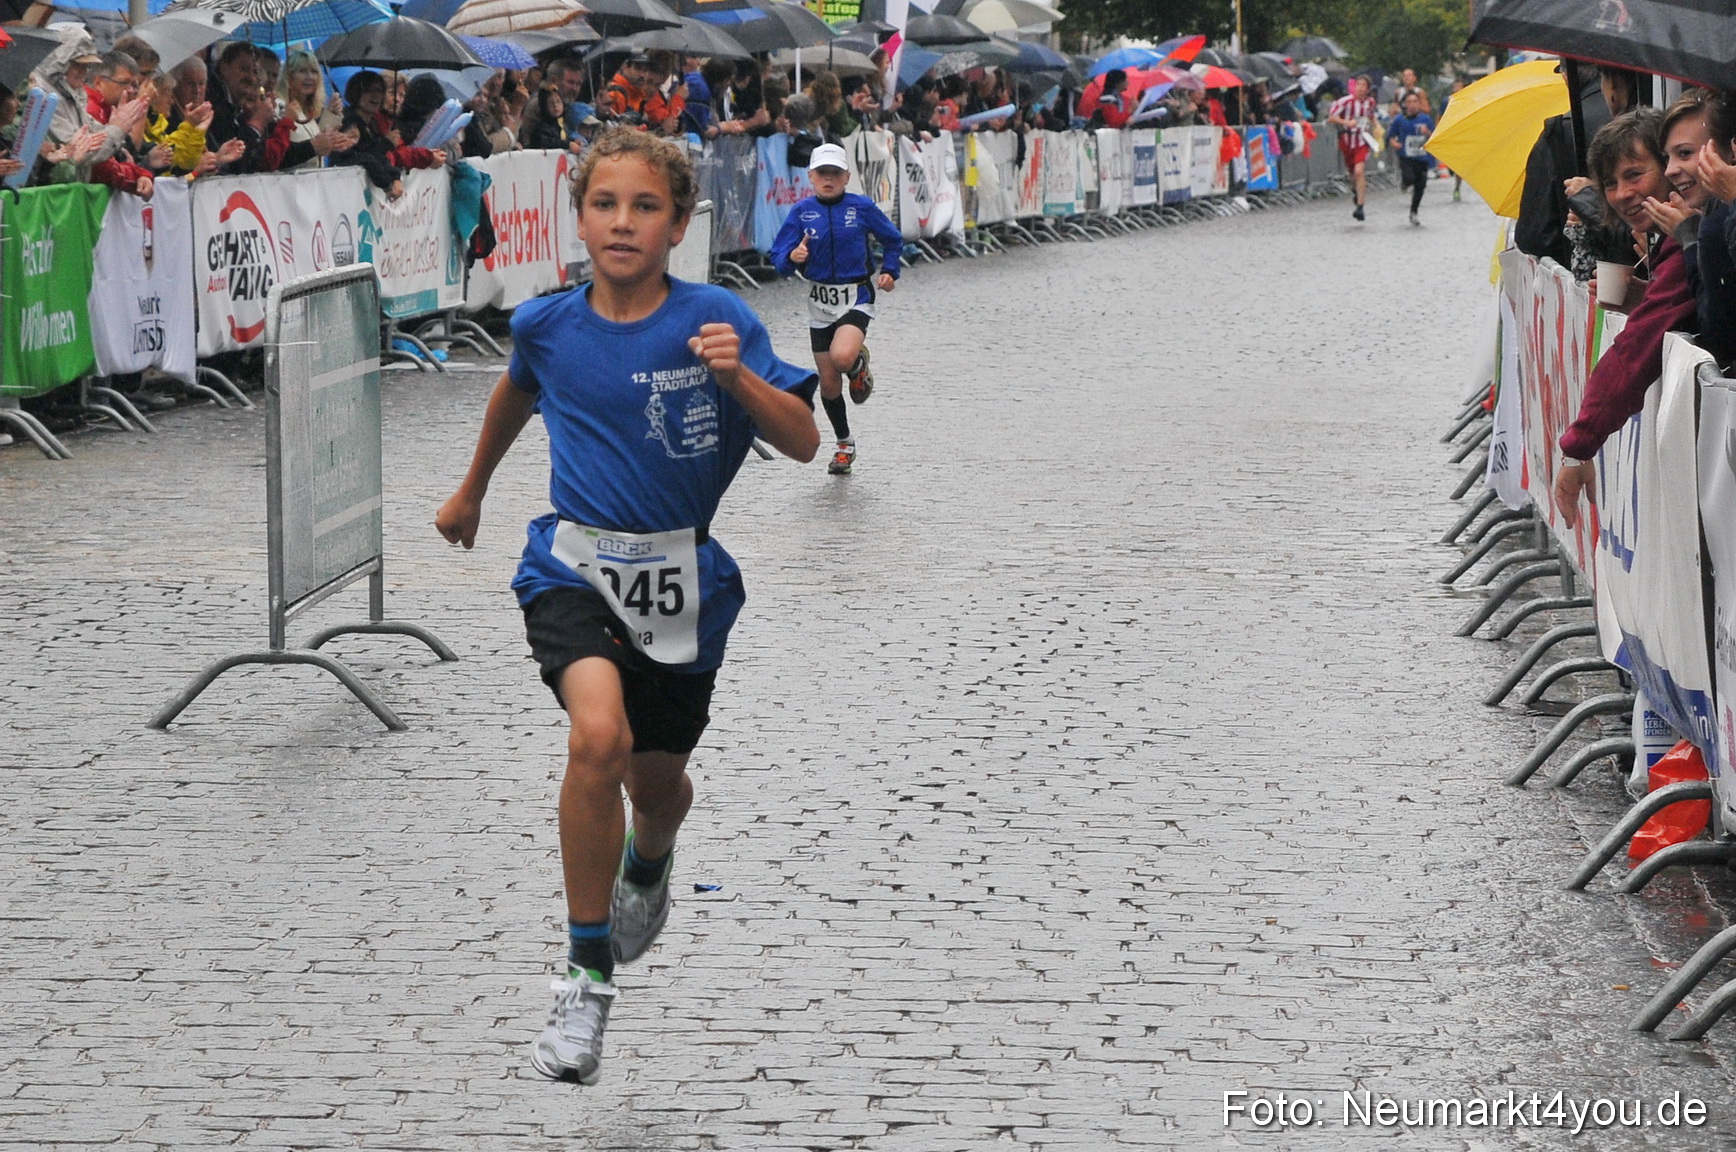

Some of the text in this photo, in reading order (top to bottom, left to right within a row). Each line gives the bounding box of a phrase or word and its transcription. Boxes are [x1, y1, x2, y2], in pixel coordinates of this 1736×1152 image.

[809, 284, 850, 306] 4031
[631, 372, 651, 384] 12.
[651, 373, 709, 392] STADTLAUF
[597, 538, 653, 556] BOCK
